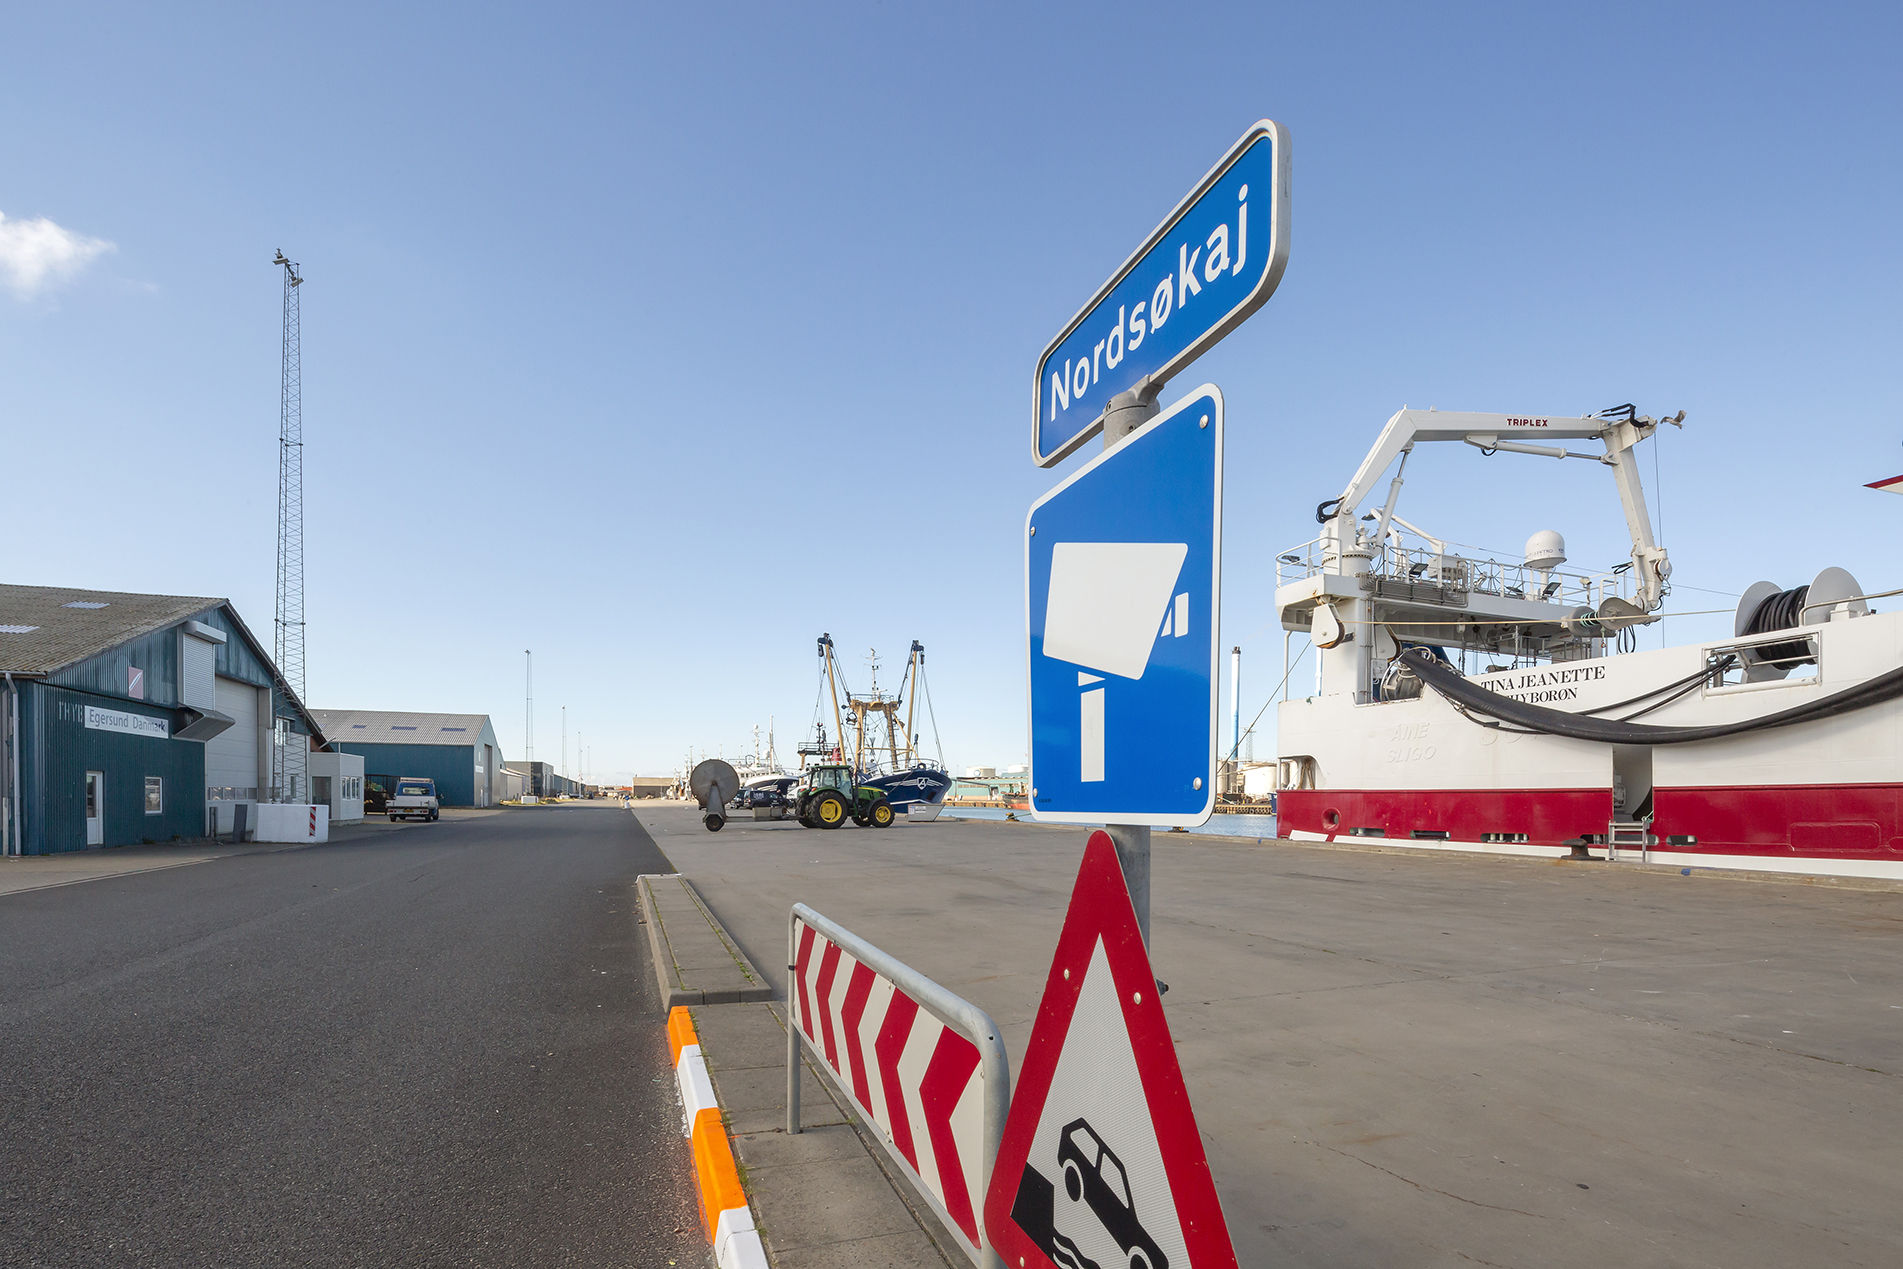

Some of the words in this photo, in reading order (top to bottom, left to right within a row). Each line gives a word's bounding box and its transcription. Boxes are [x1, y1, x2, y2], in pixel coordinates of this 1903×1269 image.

[1050, 183, 1249, 422] Nordsøkaj
[1506, 418, 1548, 427] TRIPLEX
[1480, 677, 1515, 692] TINA
[1518, 665, 1606, 689] JEANETTE
[1507, 687, 1578, 704] HYBORØN
[89, 708, 129, 728] Egersund
[132, 716, 166, 733] Danmark
[1386, 745, 1437, 763] SLIGO
